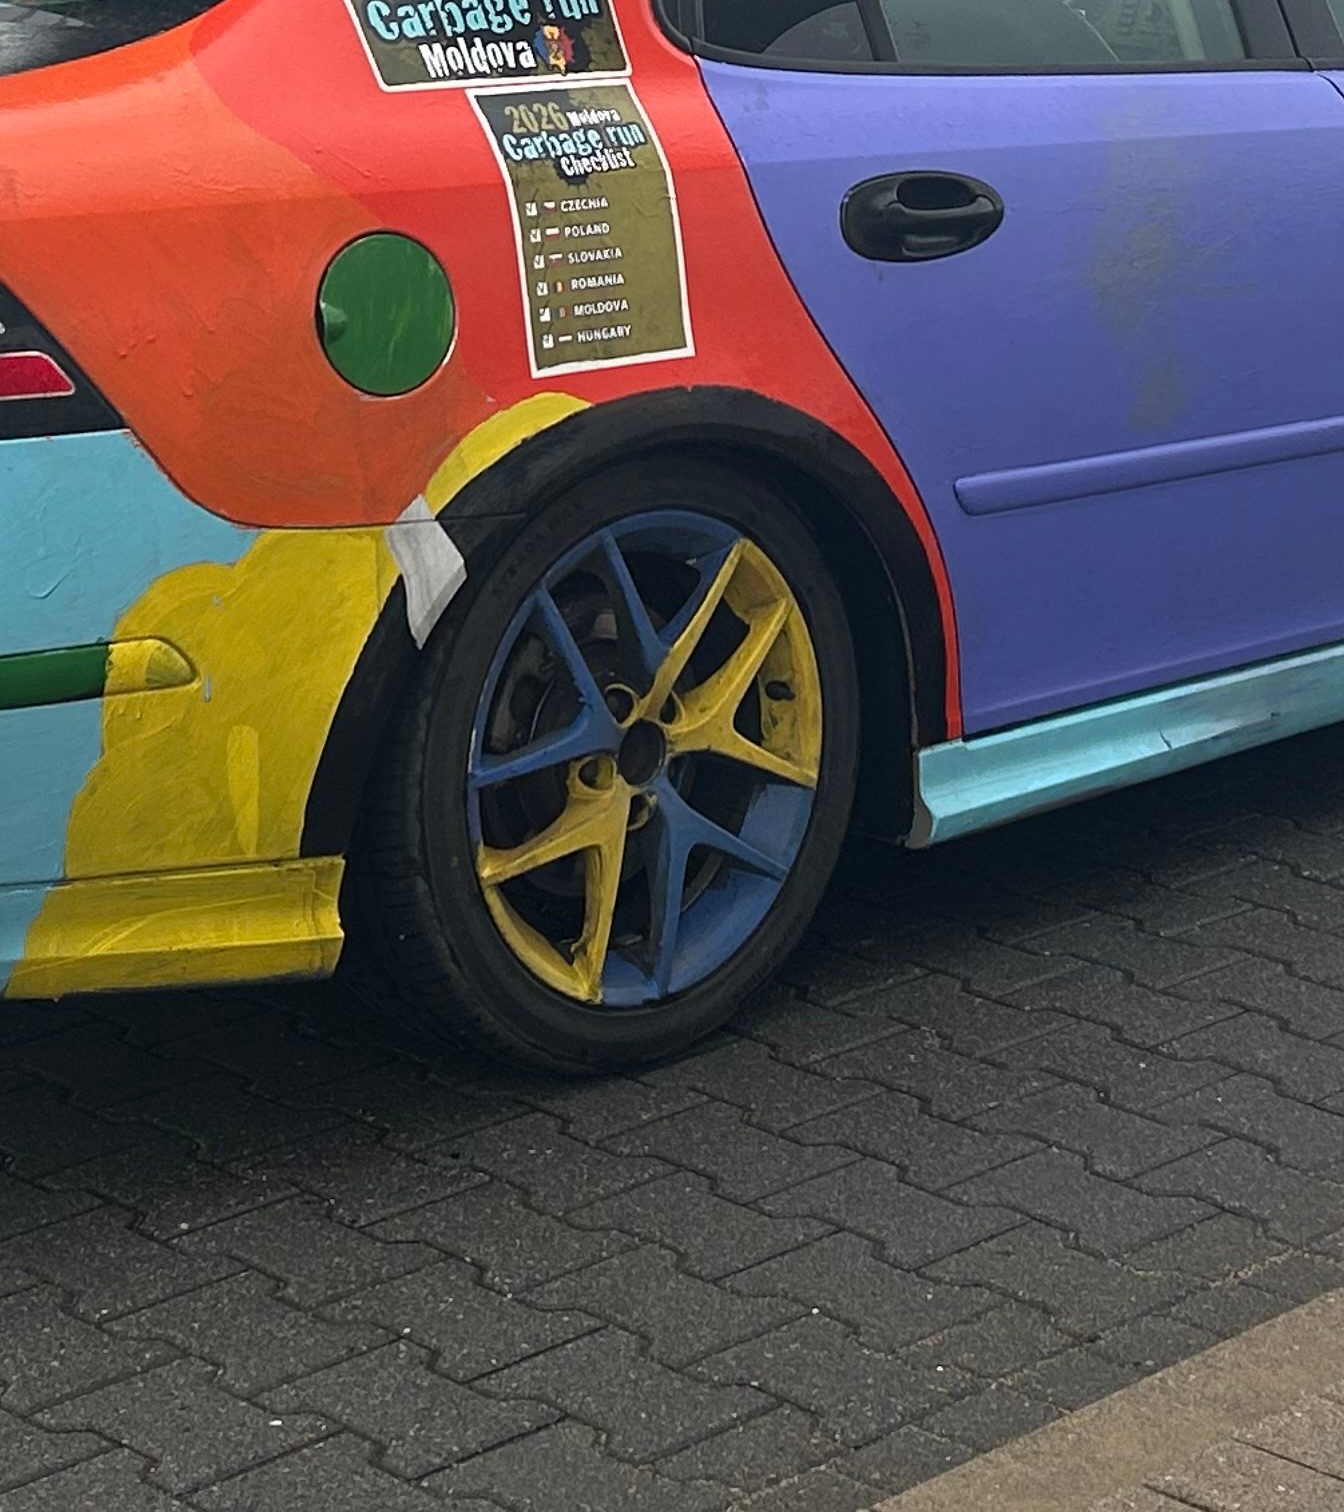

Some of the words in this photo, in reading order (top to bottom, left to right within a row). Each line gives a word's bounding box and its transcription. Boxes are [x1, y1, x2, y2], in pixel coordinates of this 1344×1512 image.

[418, 37, 537, 79] Moldova
[504, 101, 569, 134] 2026
[502, 128, 604, 161] Carbage
[605, 123, 646, 147] run
[560, 147, 636, 176] Checklist
[560, 197, 609, 212] CZECHIA
[564, 222, 610, 238] POLAND
[567, 246, 623, 264] SLOVAKIA
[570, 273, 625, 290] ROMANIA
[573, 299, 629, 317] MOLDOVA
[577, 324, 632, 343] HUNGARY
